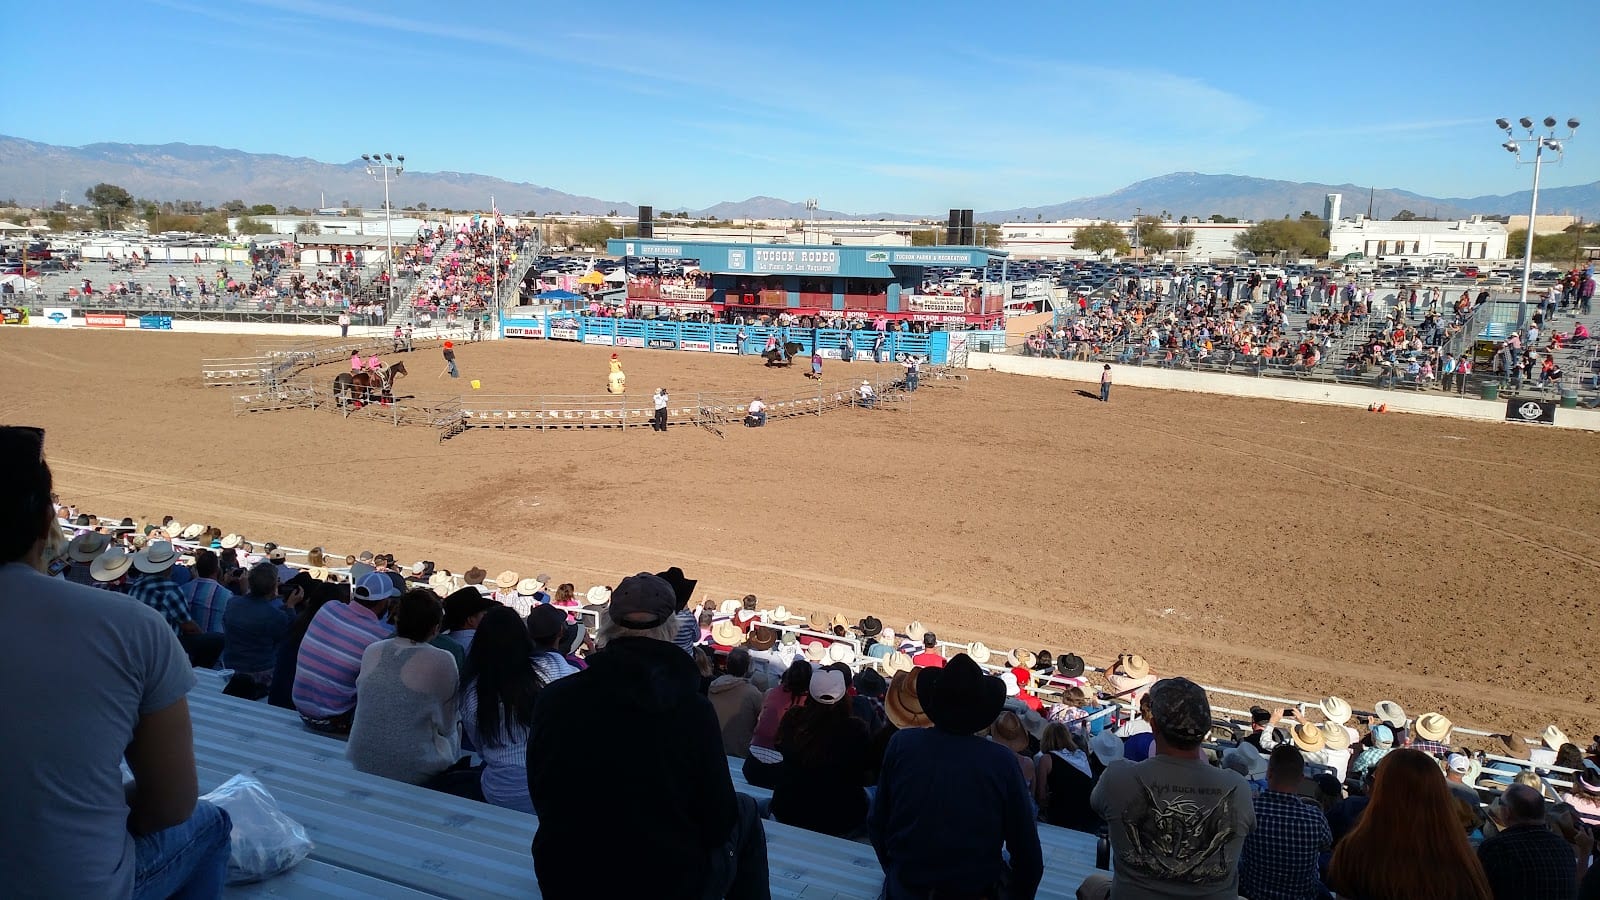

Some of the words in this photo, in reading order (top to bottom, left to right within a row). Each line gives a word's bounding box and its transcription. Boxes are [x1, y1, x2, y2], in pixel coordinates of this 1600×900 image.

[756, 250, 796, 262] TUCSON
[801, 251, 835, 263] RODEO
[1172, 785, 1195, 794] BUCK
